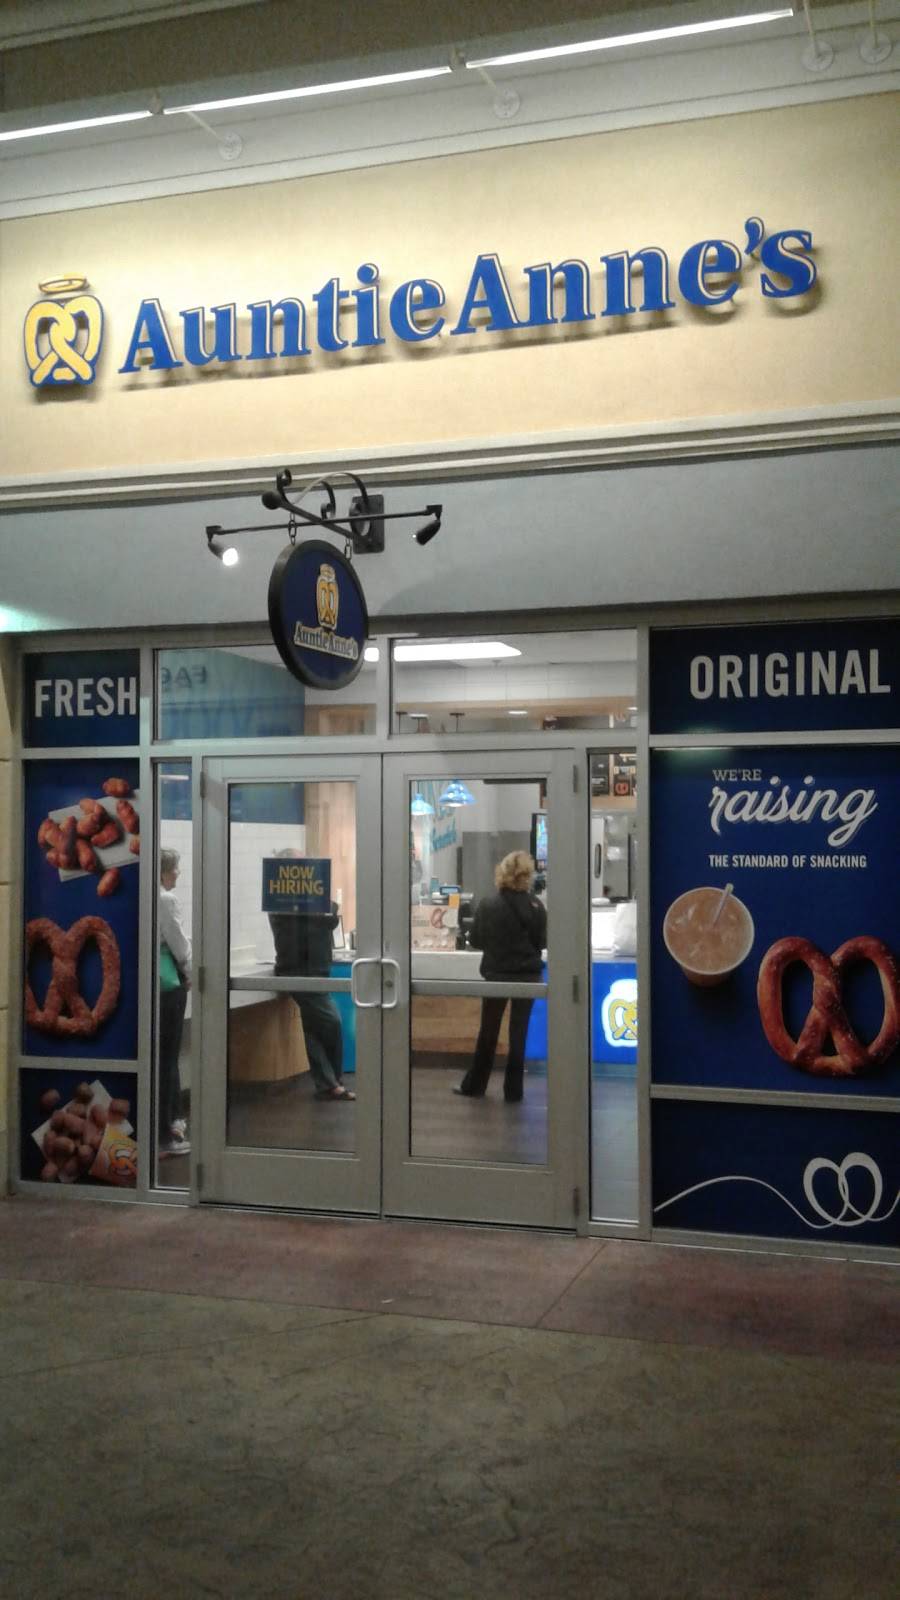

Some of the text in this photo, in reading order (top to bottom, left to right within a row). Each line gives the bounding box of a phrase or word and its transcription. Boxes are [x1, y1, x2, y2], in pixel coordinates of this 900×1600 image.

[690, 648, 891, 699] ORIGINAL
[34, 676, 137, 718] FRESH
[712, 769, 762, 782] WE'RE
[709, 776, 878, 847] raising
[709, 854, 867, 868] THE STANDARD OF SNACKING
[279, 866, 315, 880] NOW
[269, 880, 325, 896] HIRING
